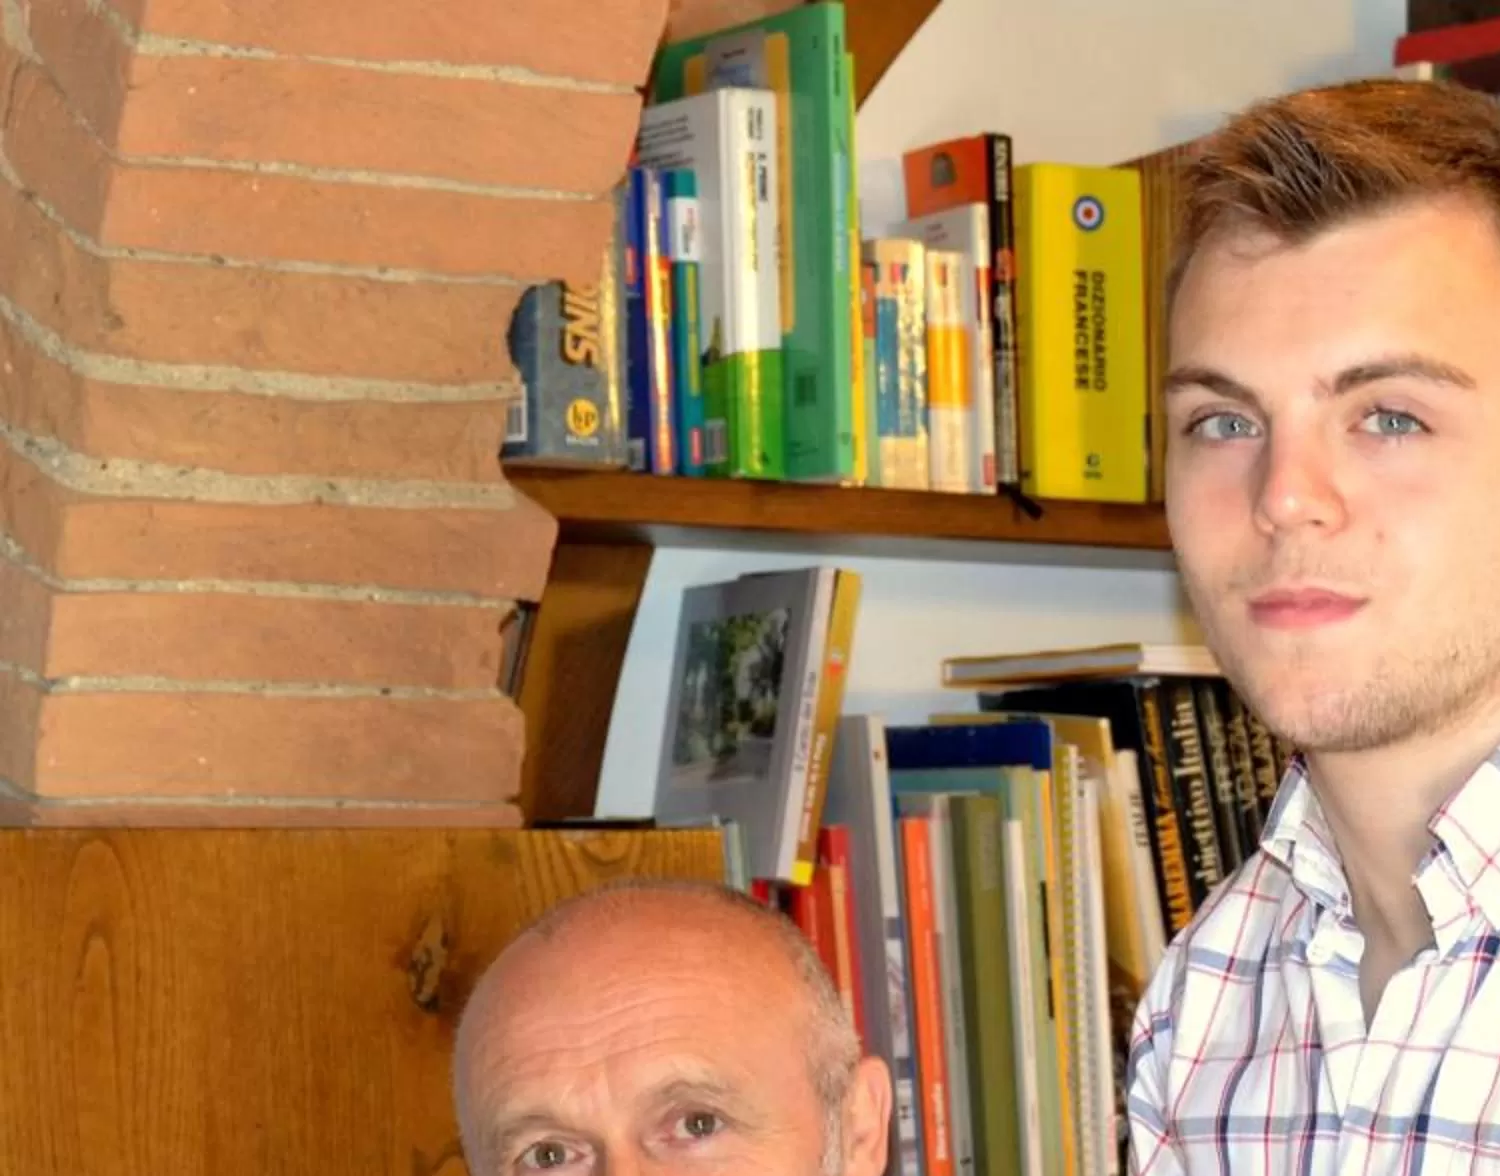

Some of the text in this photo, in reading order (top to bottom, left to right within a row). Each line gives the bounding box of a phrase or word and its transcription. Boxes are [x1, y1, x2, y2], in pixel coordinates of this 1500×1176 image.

[1074, 269, 1090, 390] FRANCESE
[1091, 270, 1106, 391] DIZIONARIO
[1172, 701, 1201, 777] Italia
[1229, 715, 1257, 811] VENEZIA
